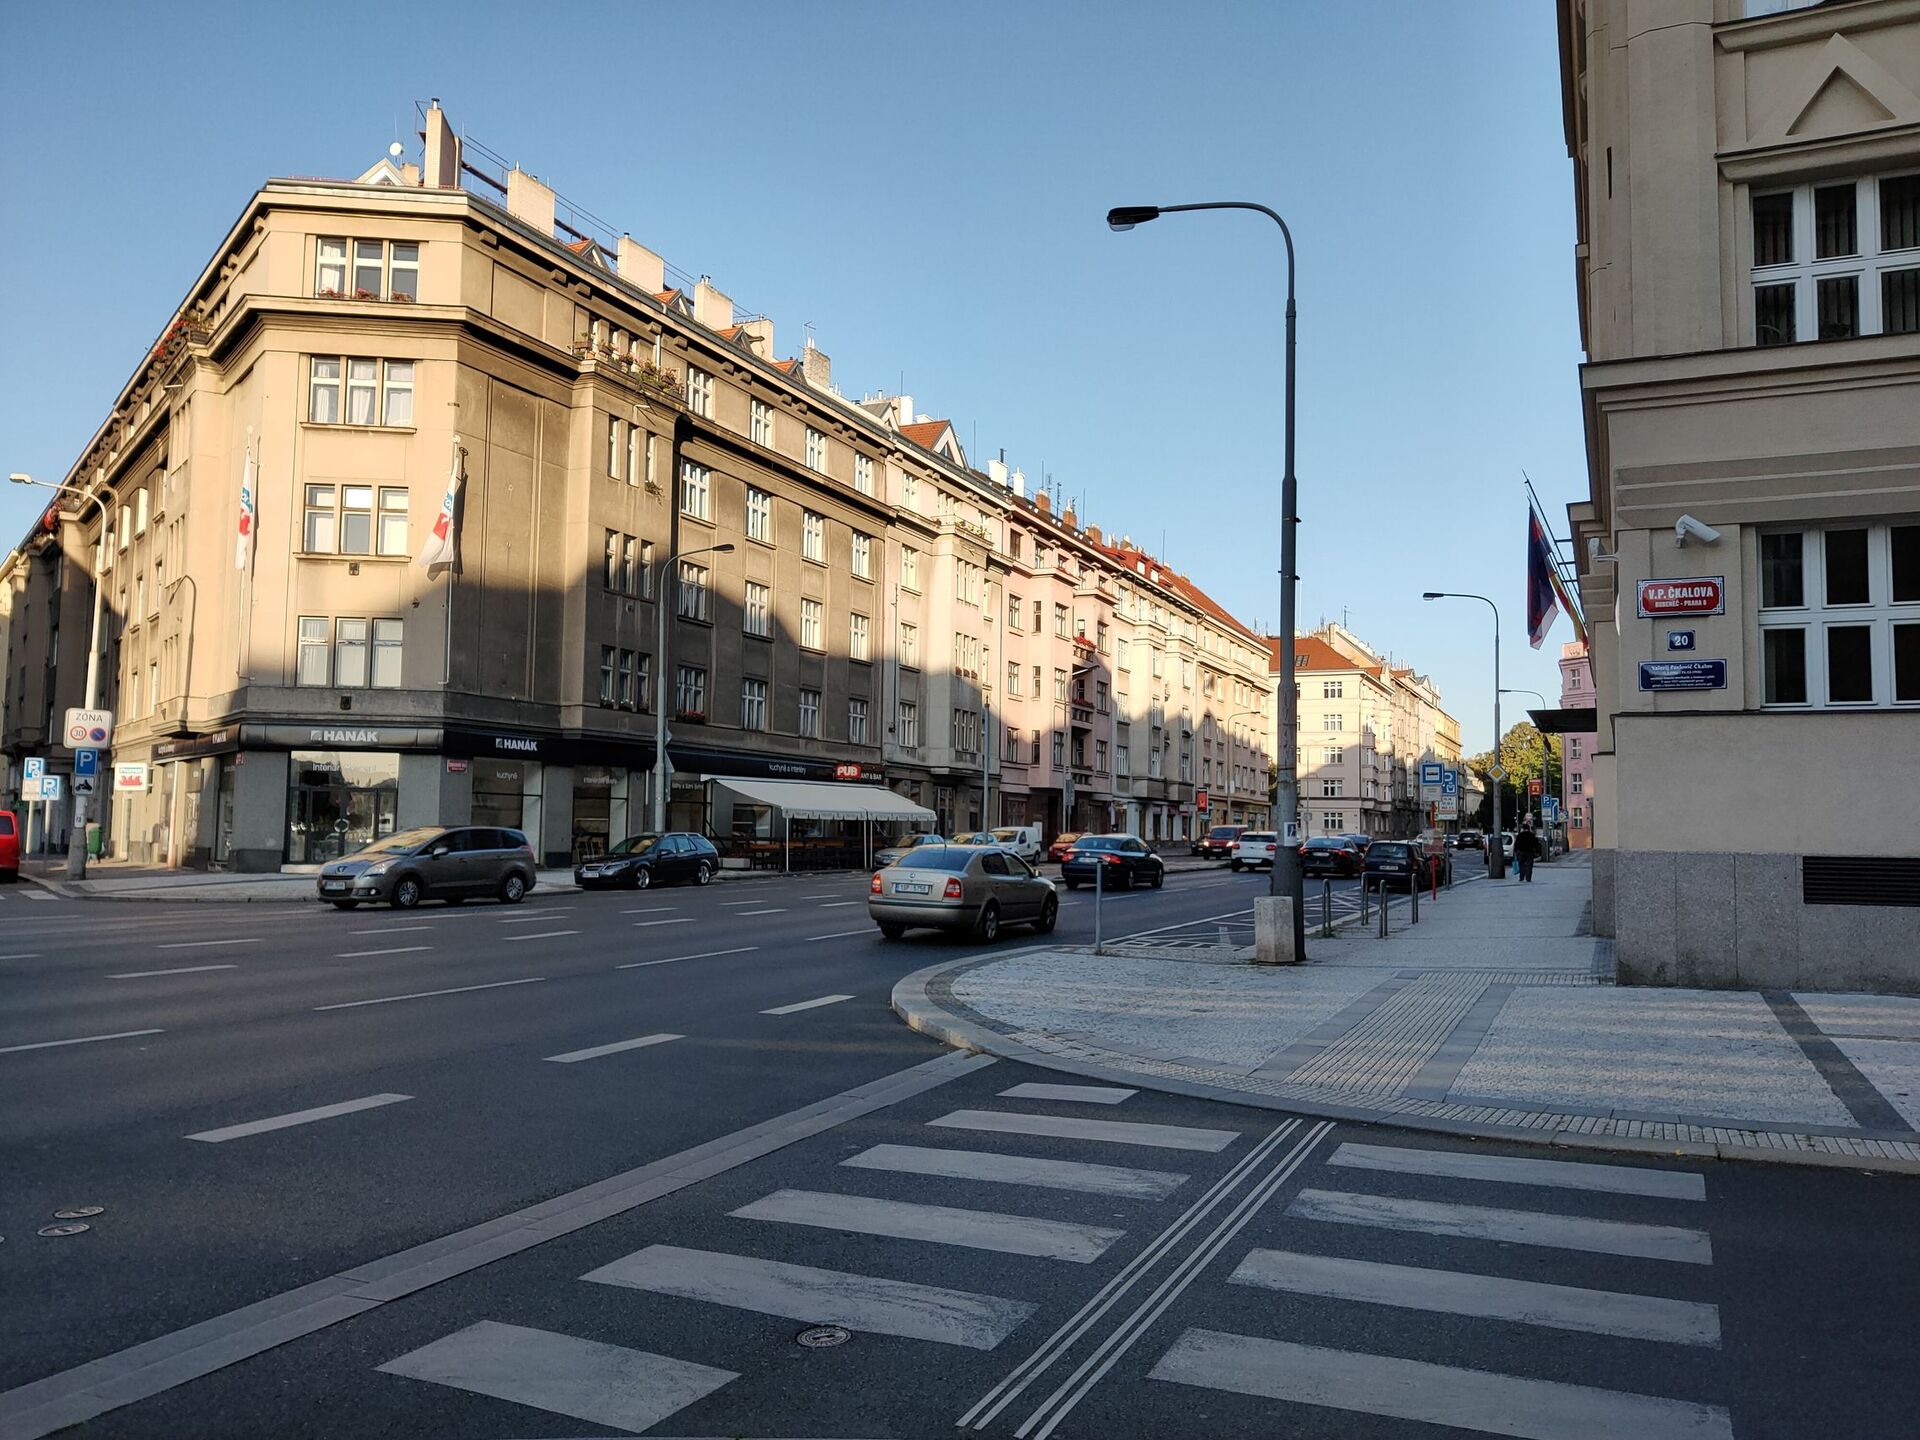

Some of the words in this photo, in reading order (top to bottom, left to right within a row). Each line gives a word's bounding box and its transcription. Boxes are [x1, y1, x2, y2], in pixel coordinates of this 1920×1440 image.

[1668, 586, 1713, 598] ČKALOVA
[1674, 636, 1688, 646] 20
[324, 729, 378, 741] HANÁK
[504, 738, 538, 751] HANÁK
[80, 752, 93, 767] P
[837, 766, 857, 776] PUB
